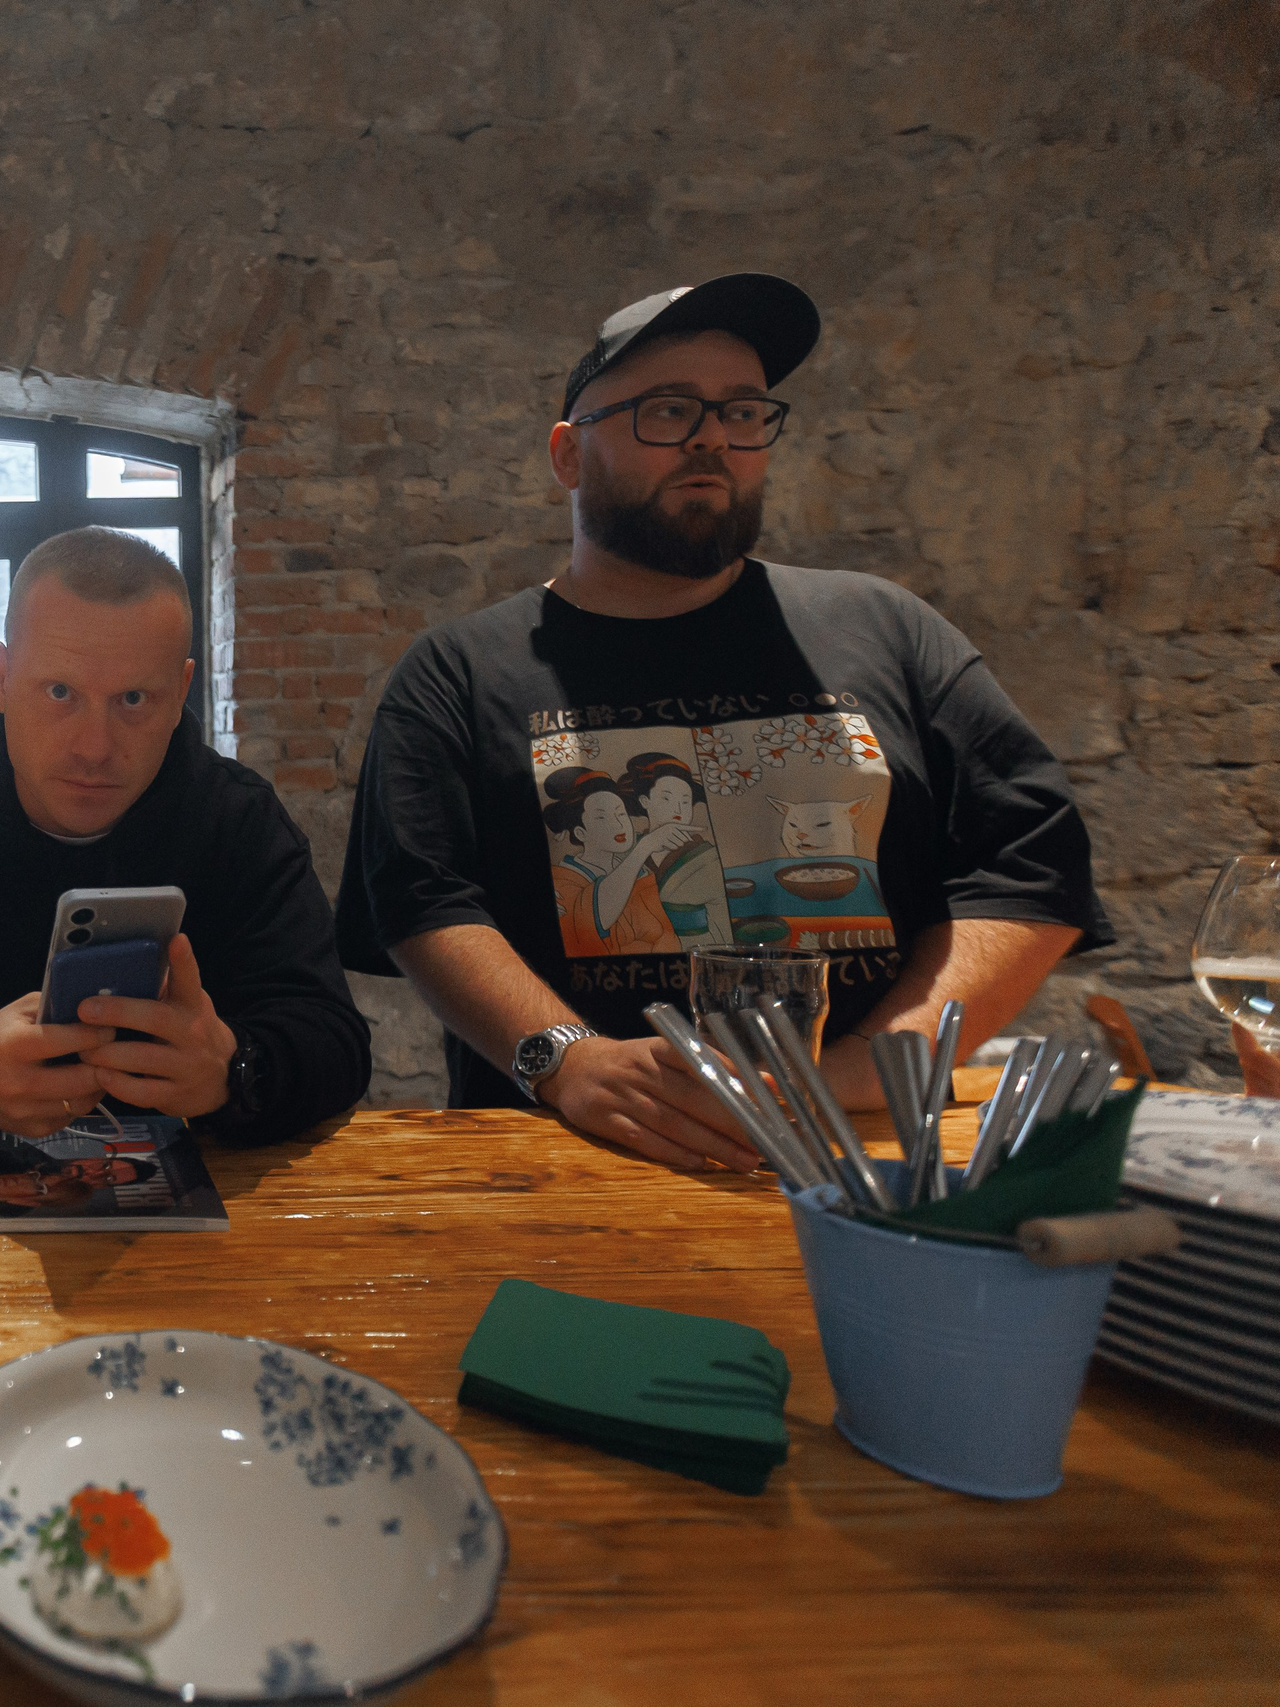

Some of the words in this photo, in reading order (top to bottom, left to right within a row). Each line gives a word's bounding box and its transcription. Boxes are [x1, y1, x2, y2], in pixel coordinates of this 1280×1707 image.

[528, 694, 769, 735] 私は酔っていない
